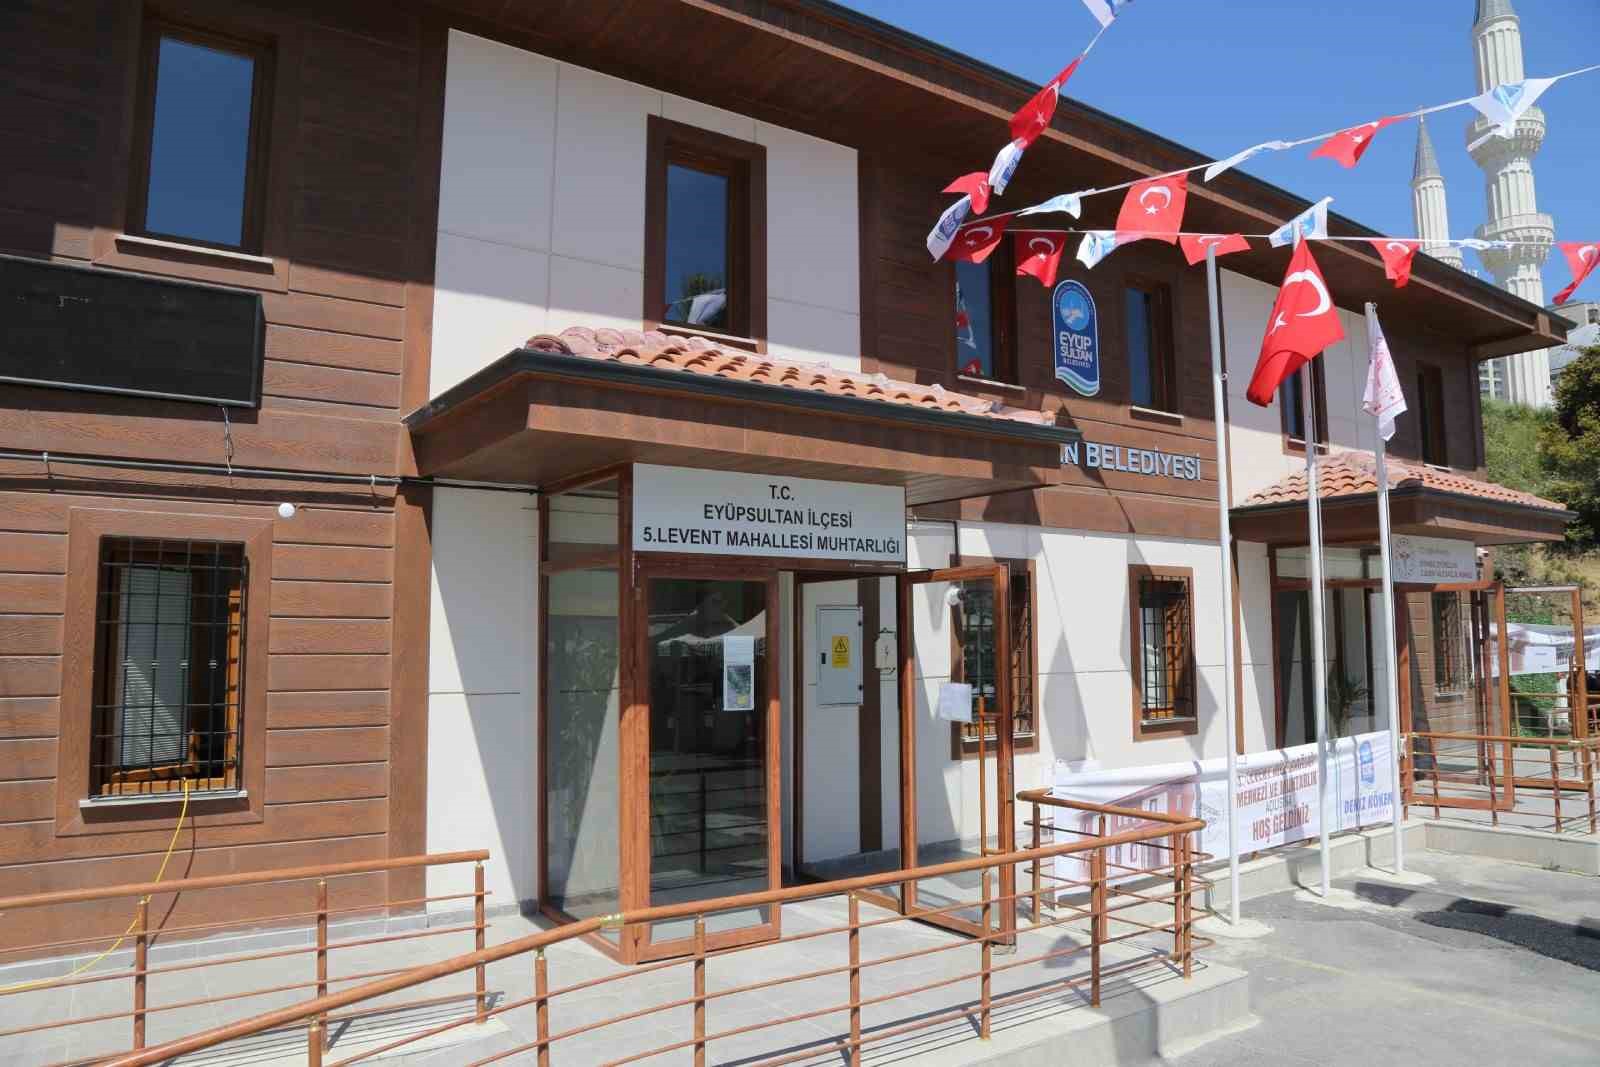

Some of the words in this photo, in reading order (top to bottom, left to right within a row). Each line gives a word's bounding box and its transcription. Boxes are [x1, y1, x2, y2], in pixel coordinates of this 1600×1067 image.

[1060, 345, 1093, 363] SULTAN
[1086, 442, 1201, 481] BELEDİYESİ
[768, 484, 796, 501] T.C.
[703, 502, 804, 525] EYÜPSULTAN
[807, 507, 853, 530] İLÇESİ
[642, 526, 723, 546] 5.LEVENT
[726, 530, 814, 550] MAHALLESİ
[817, 534, 901, 555] MUHTARLIĞI
[1269, 782, 1278, 799] VE
[1252, 817, 1271, 843] HOŞ
[1273, 803, 1310, 834] GELDİNİZ
